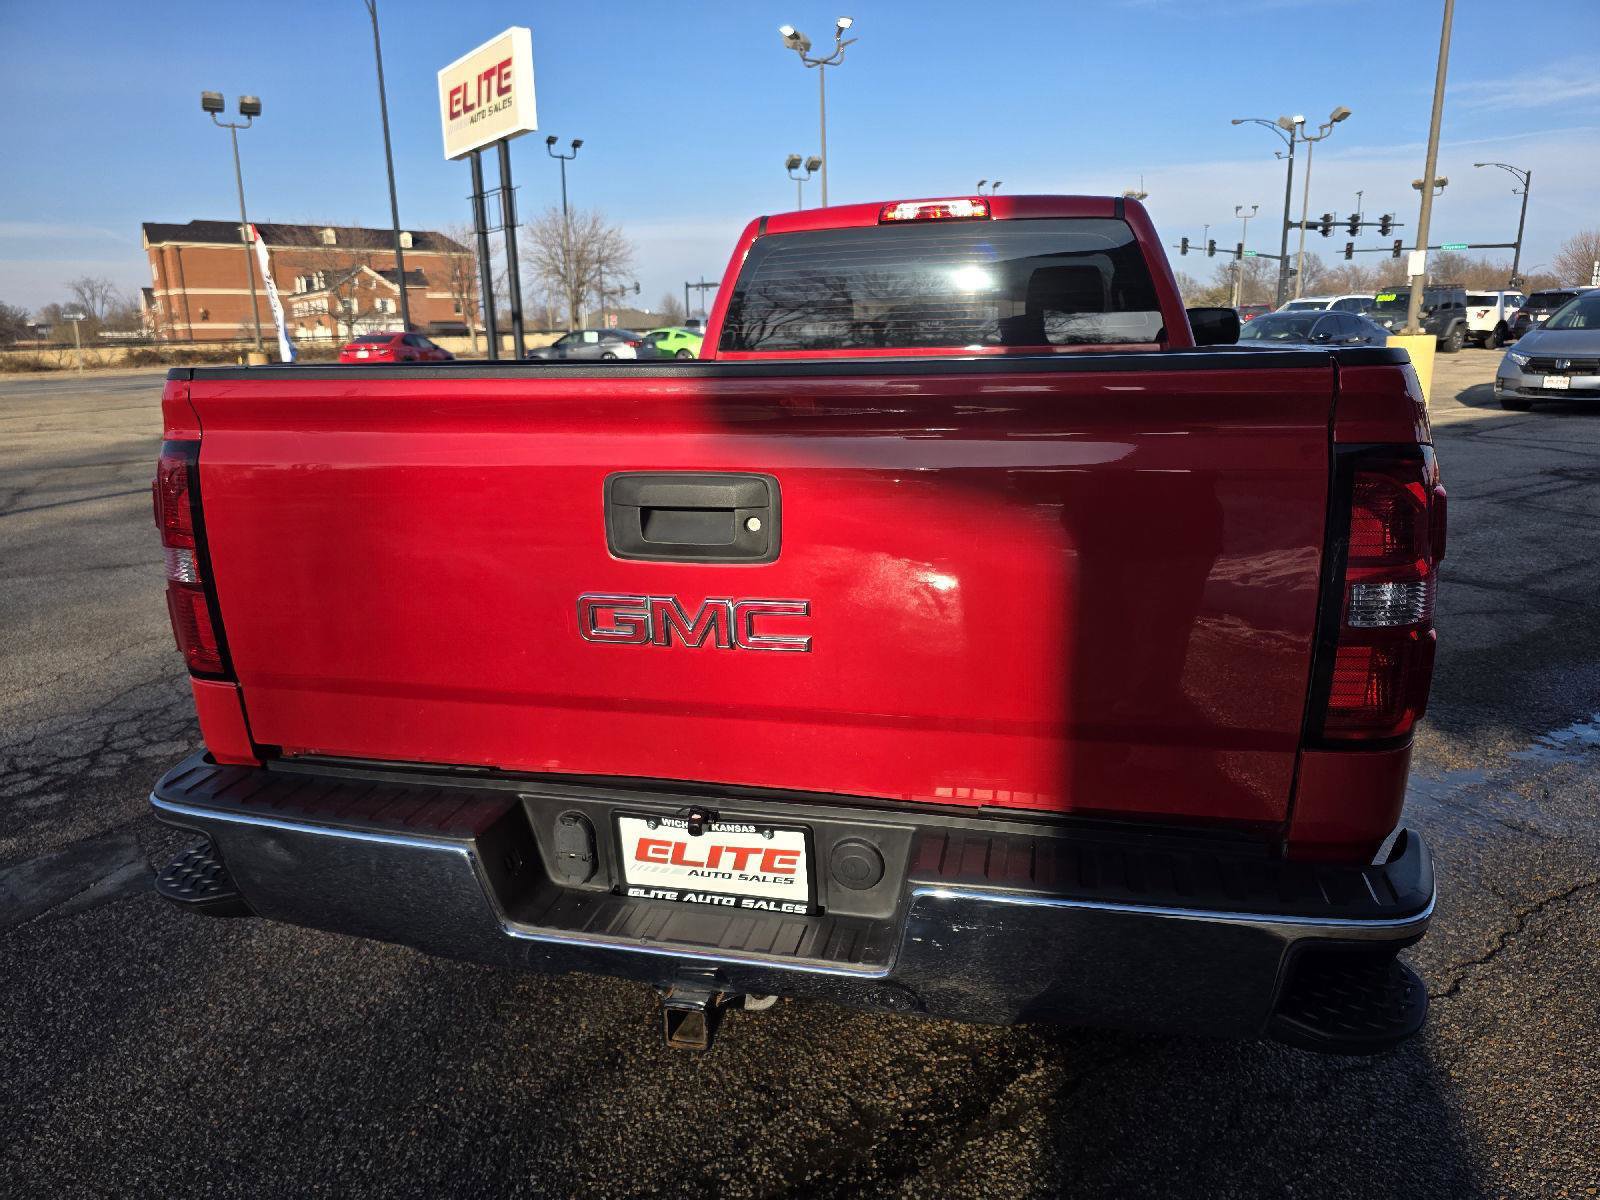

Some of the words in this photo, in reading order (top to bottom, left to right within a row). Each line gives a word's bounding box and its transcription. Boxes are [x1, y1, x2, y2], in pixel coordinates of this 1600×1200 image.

[449, 57, 513, 121] ELITE
[469, 109, 487, 124] AUTO
[488, 97, 513, 116] SALES
[576, 593, 812, 652] GMC
[711, 823, 756, 833] KANSAS
[635, 838, 801, 874] ELITE
[688, 870, 732, 879] AUTO
[738, 874, 795, 884] SALES
[628, 887, 678, 900] ELITE
[683, 893, 735, 906] AUTO
[741, 900, 808, 915] SALES
